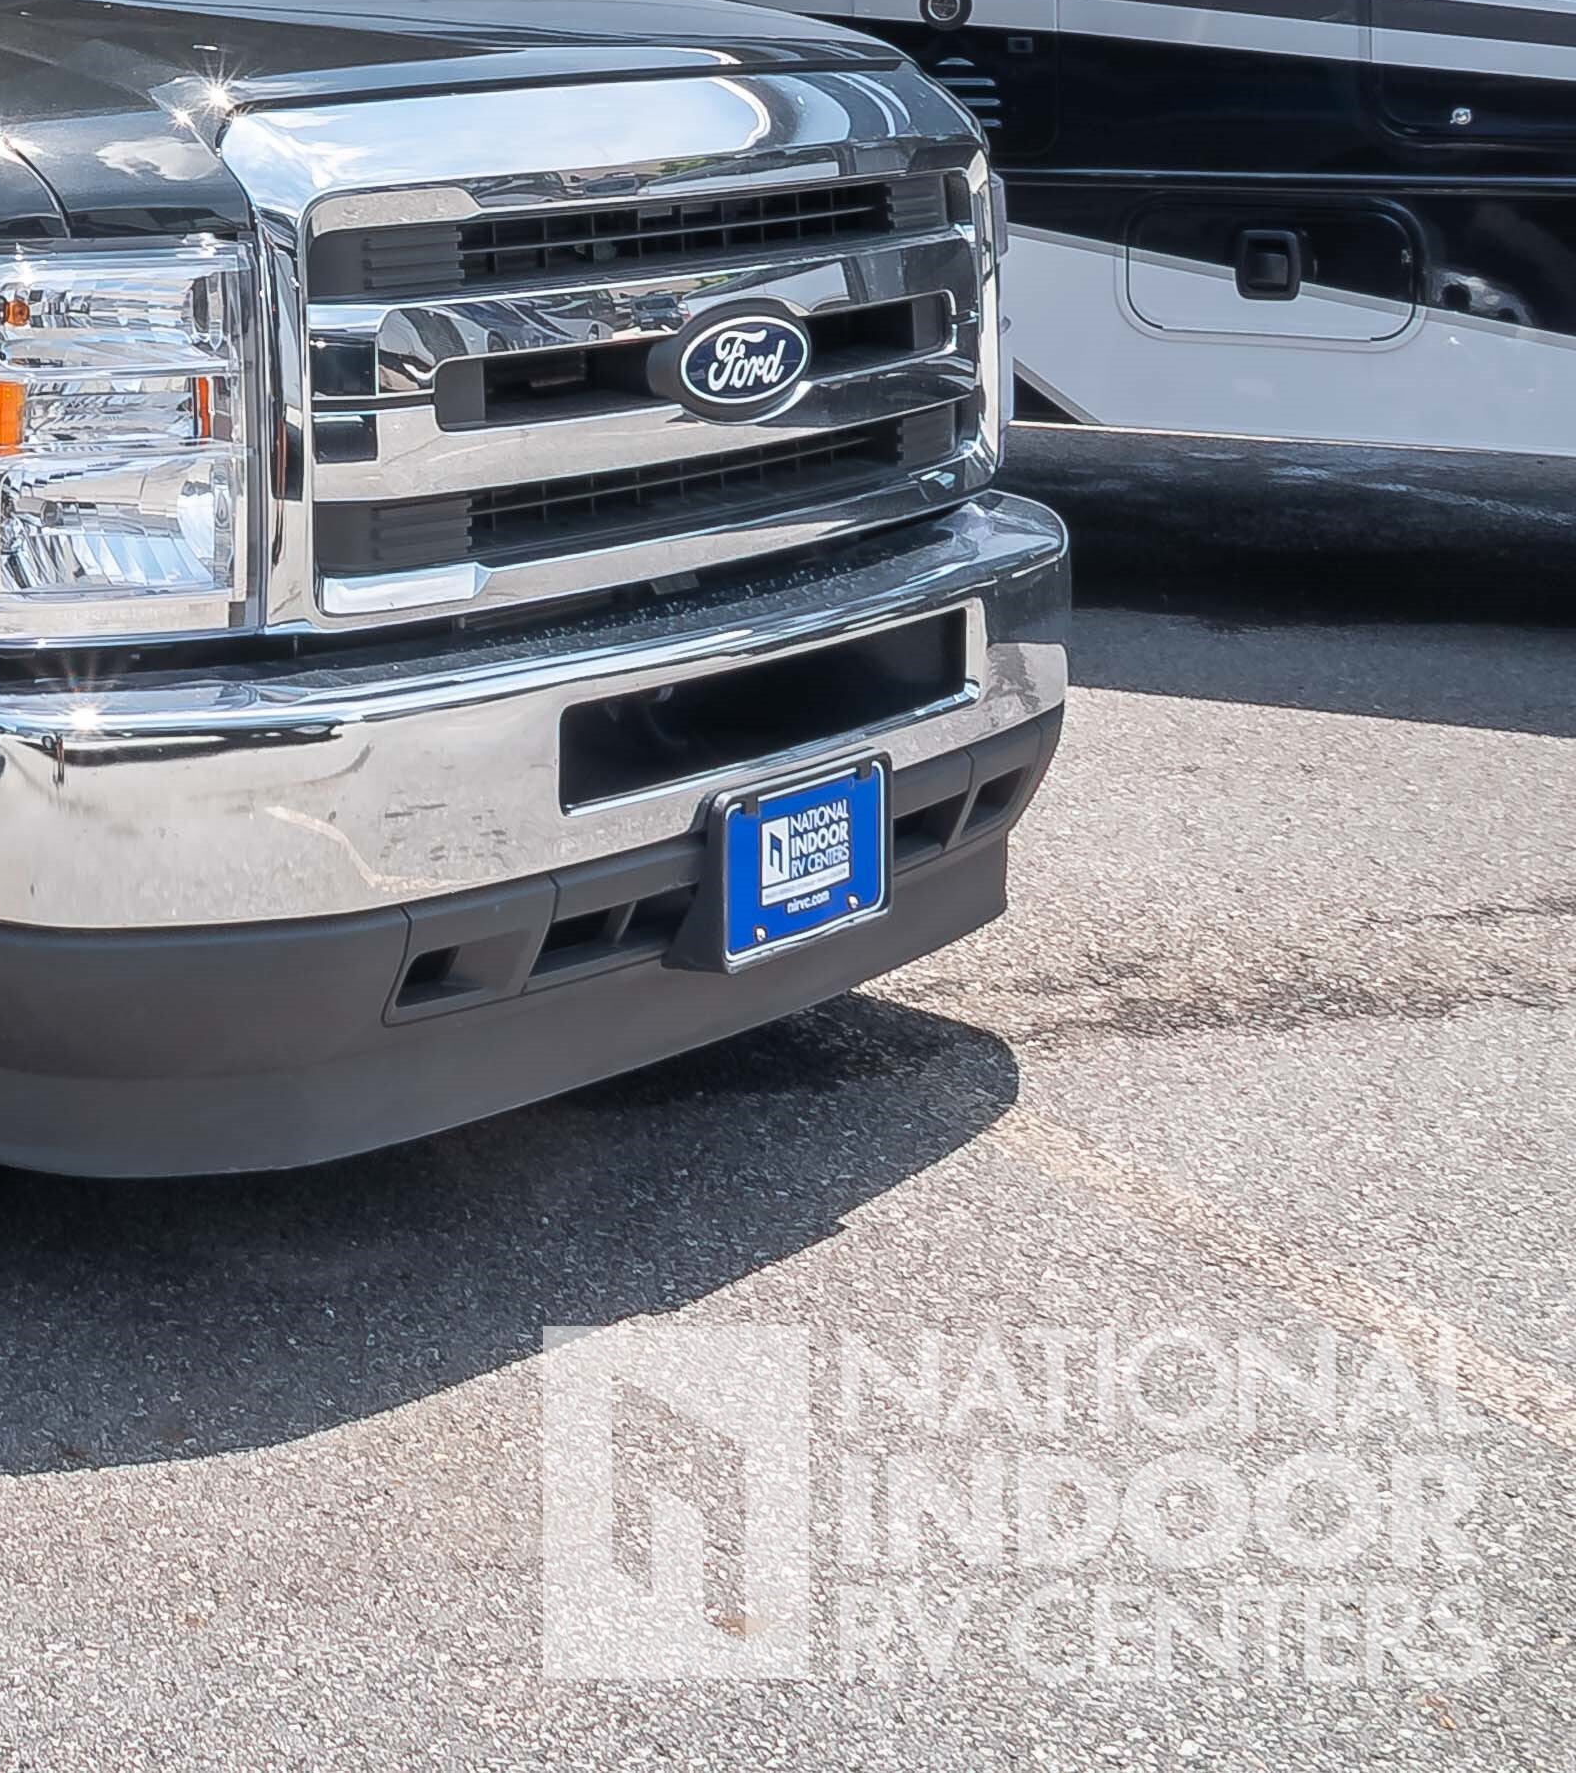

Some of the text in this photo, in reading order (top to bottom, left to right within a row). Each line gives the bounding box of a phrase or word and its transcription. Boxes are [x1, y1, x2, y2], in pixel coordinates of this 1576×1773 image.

[707, 329, 787, 392] Ford
[790, 798, 849, 835] NATIONAL
[791, 822, 849, 858] INDOOR
[791, 843, 850, 879] RV CENTERS
[787, 890, 830, 914] nirvc.com
